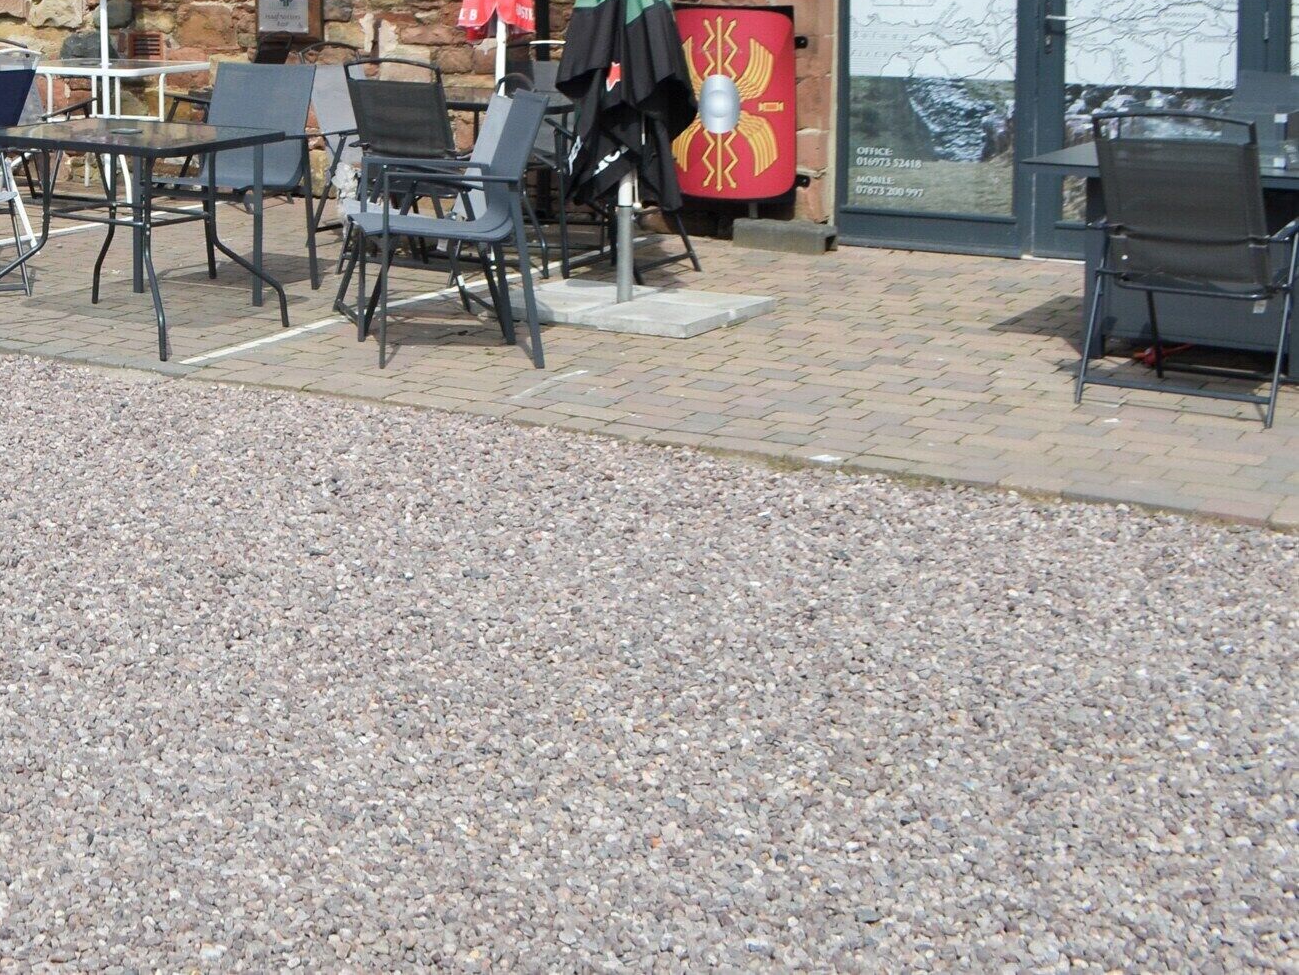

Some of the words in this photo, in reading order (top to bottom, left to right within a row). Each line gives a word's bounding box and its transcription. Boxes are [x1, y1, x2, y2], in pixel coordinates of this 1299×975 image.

[856, 146, 894, 156] OFFICE:
[856, 156, 891, 167] 016973
[893, 158, 922, 169] 52418
[855, 175, 896, 185] MOBILE:
